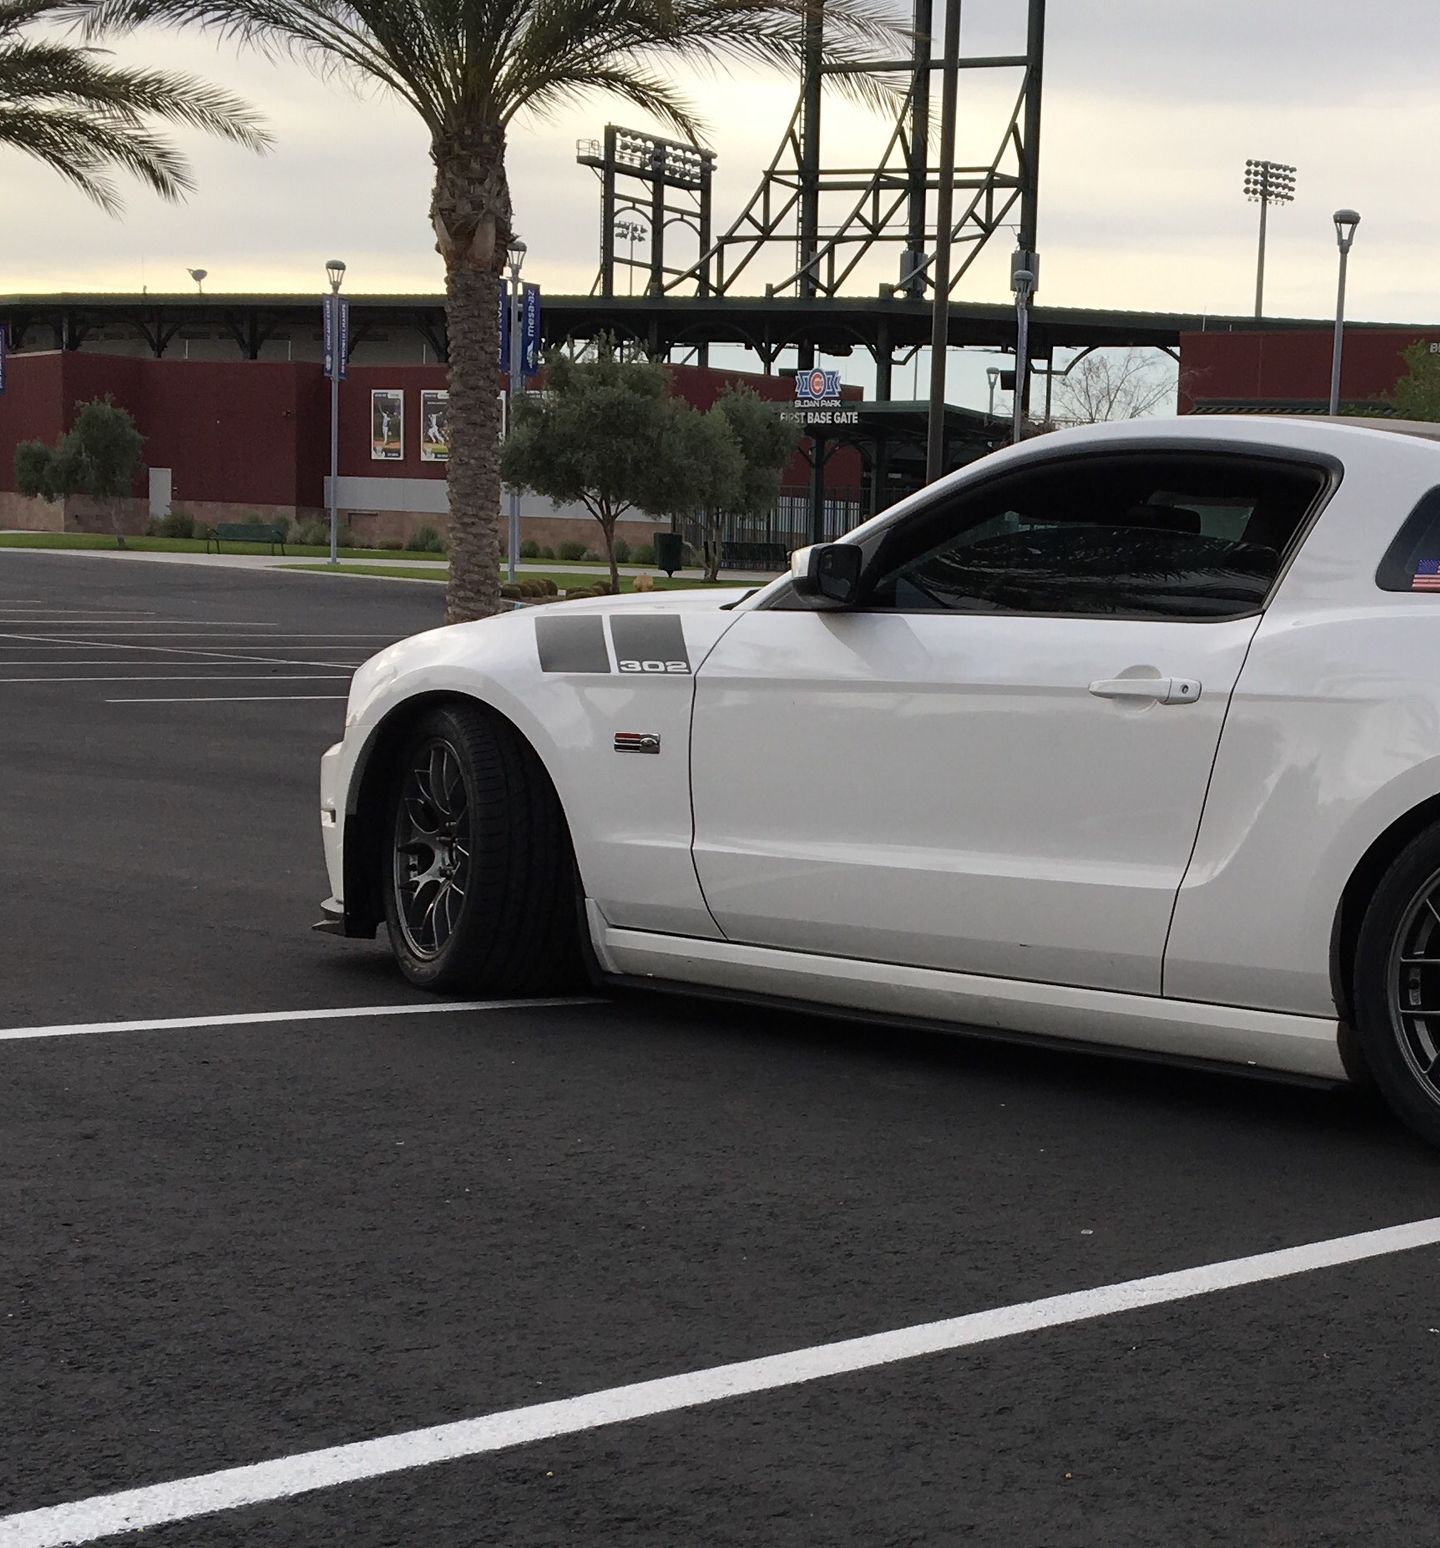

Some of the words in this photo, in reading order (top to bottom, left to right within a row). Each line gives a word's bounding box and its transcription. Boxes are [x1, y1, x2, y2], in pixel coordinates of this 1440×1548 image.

[794, 400, 820, 408] SLOAN
[820, 400, 841, 408] PARK
[807, 412, 832, 424] BASE
[833, 412, 859, 424] GATE
[619, 660, 690, 672] 302
